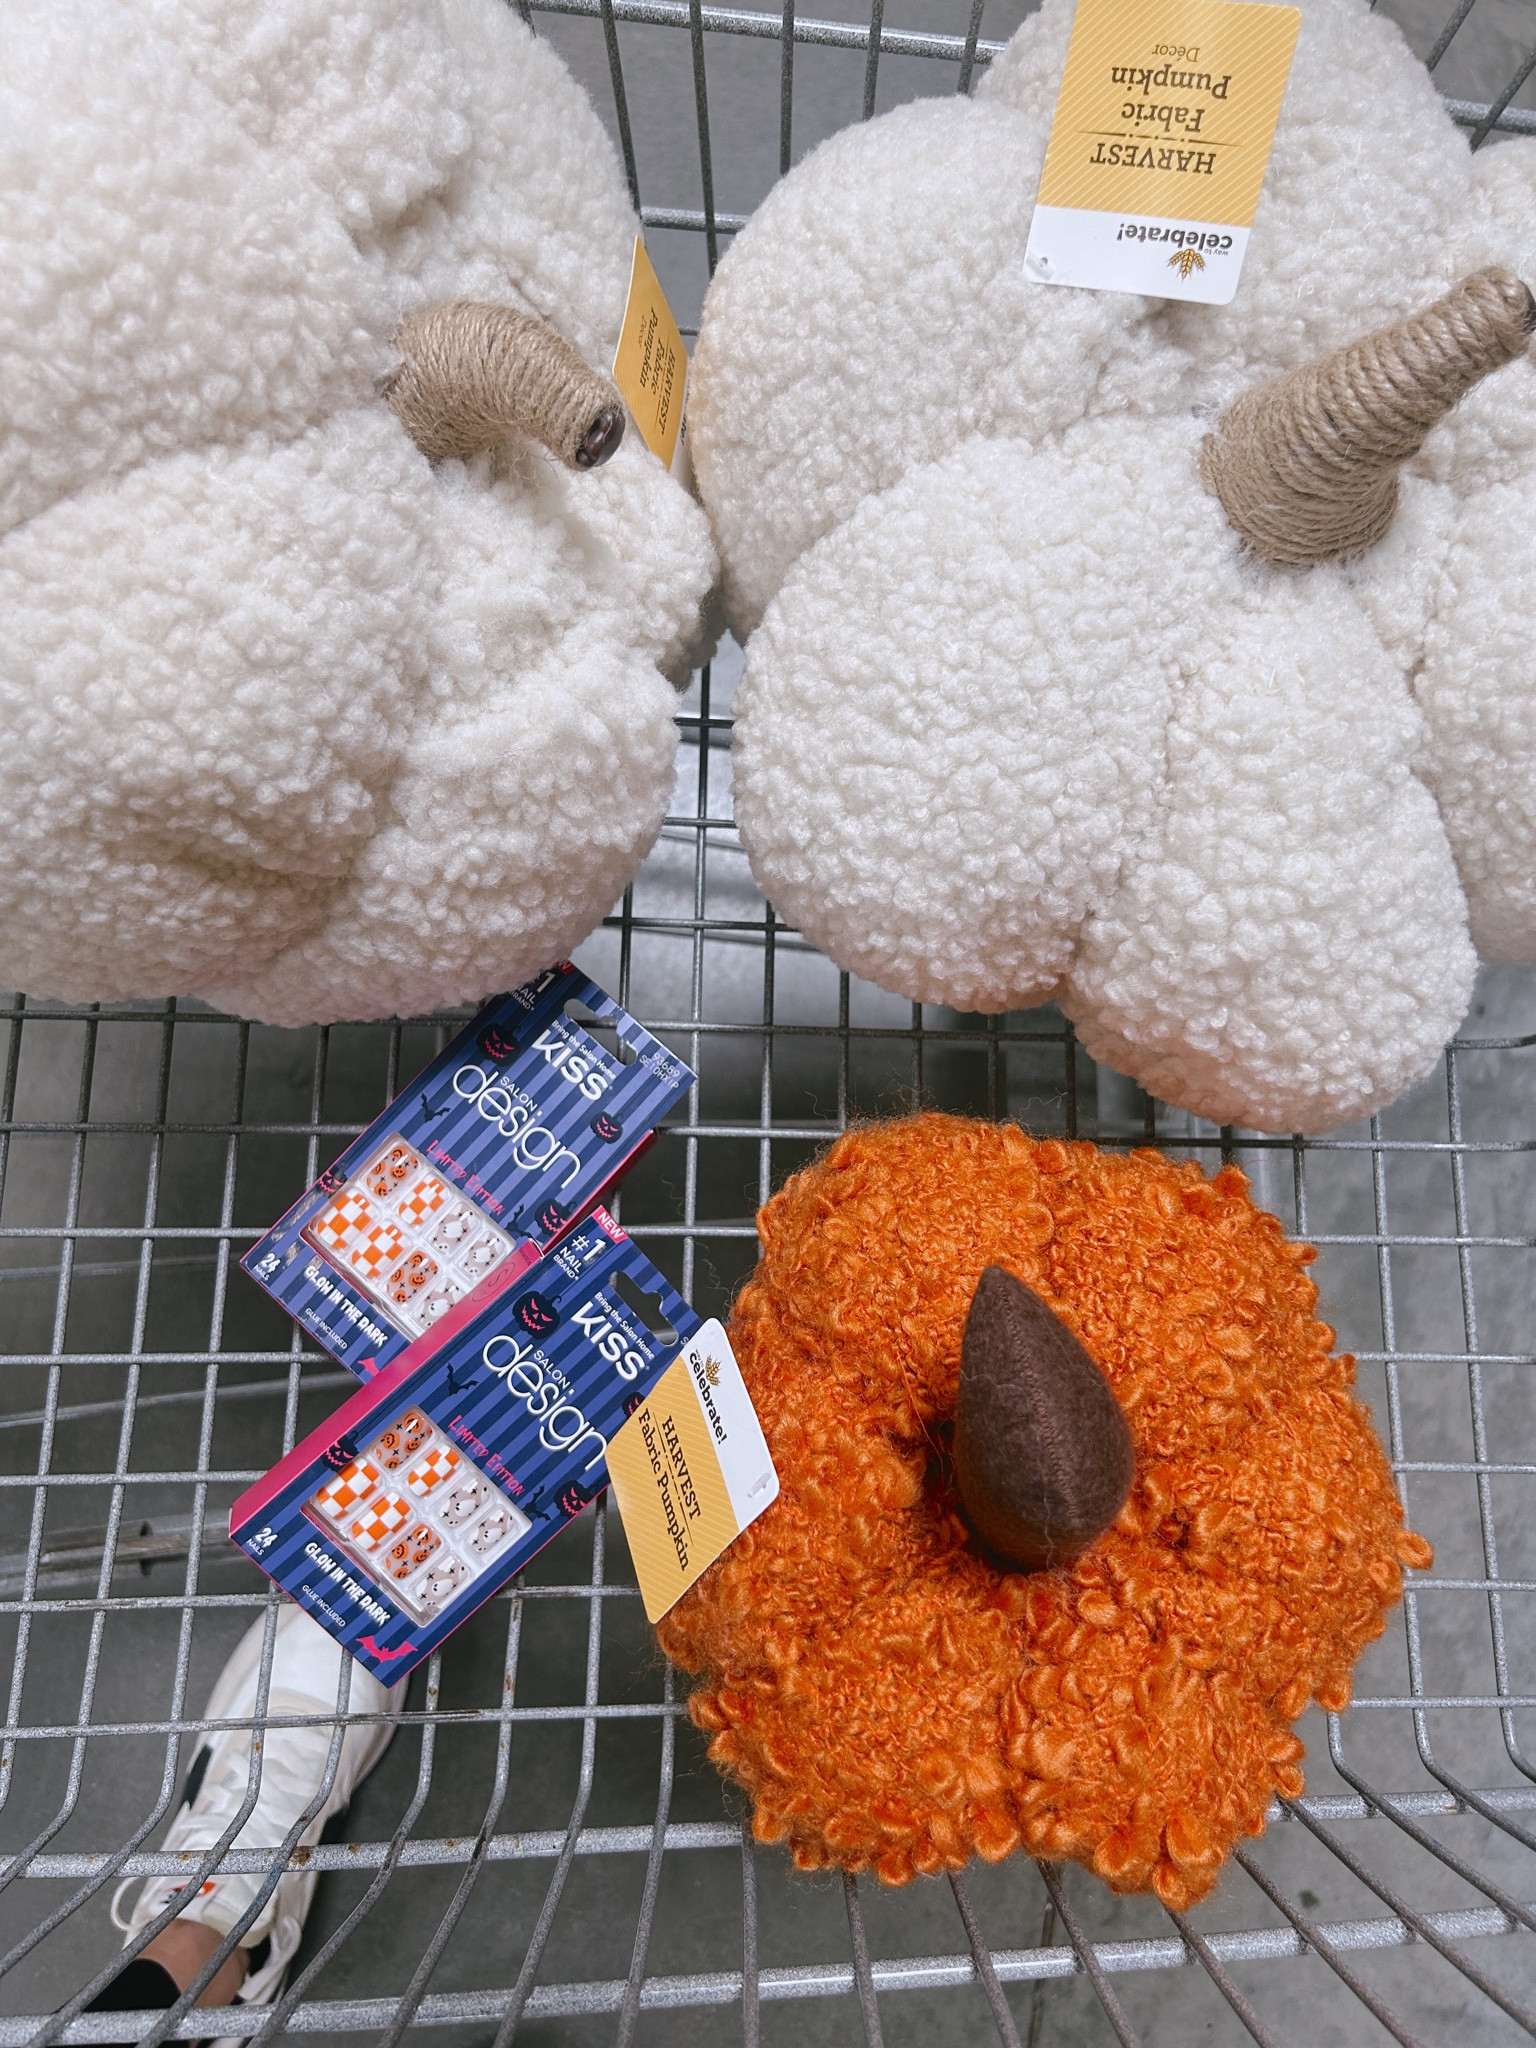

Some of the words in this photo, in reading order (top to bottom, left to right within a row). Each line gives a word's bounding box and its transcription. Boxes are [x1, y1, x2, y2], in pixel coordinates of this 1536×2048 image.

[1152, 44, 1200, 63] Décor
[1111, 64, 1232, 100] Pumpkin
[1121, 102, 1205, 133] Fabric
[1089, 143, 1217, 175] HARVEST
[1117, 223, 1233, 251] celebrate!
[640, 306, 658, 388] Pumpkin
[651, 337, 665, 395] Fabric
[658, 347, 676, 436] HARVEST
[552, 1019, 570, 1042] Bring
[569, 1035, 580, 1050] the
[579, 1045, 598, 1068] Salon
[597, 1060, 617, 1081] Home
[653, 1052, 680, 1078] 93689
[500, 1075, 538, 1112] SALON
[453, 1064, 581, 1189] design
[597, 1211, 624, 1239] NEW
[259, 1253, 281, 1273] 24
[560, 1246, 583, 1274] NAIL
[571, 1235, 607, 1262] #1
[253, 1265, 271, 1281] NAILS
[304, 1265, 333, 1296] GLOW
[328, 1291, 344, 1304] IN
[339, 1298, 361, 1324] THE
[356, 1317, 389, 1348] DARK
[594, 1291, 613, 1313] Bring
[611, 1309, 622, 1323] the
[620, 1320, 638, 1341] Salon
[636, 1337, 655, 1360] Home
[305, 1307, 322, 1325] GLUE
[320, 1320, 348, 1350] INCLUDED
[533, 1349, 571, 1389] SALON
[483, 1335, 608, 1472] design
[690, 1352, 728, 1445] celebrate!
[662, 1415, 702, 1520] HARVEST
[638, 1408, 661, 1474] Fabric
[657, 1471, 689, 1572] Pumpkin
[246, 1538, 265, 1556] NAILS
[253, 1527, 278, 1547] 24
[304, 1542, 336, 1573] GLOW
[329, 1566, 347, 1582] IN
[342, 1576, 365, 1601] THE
[359, 1595, 391, 1627] DARK
[302, 1584, 320, 1601] GLUE
[317, 1598, 346, 1627] INCLUDED
